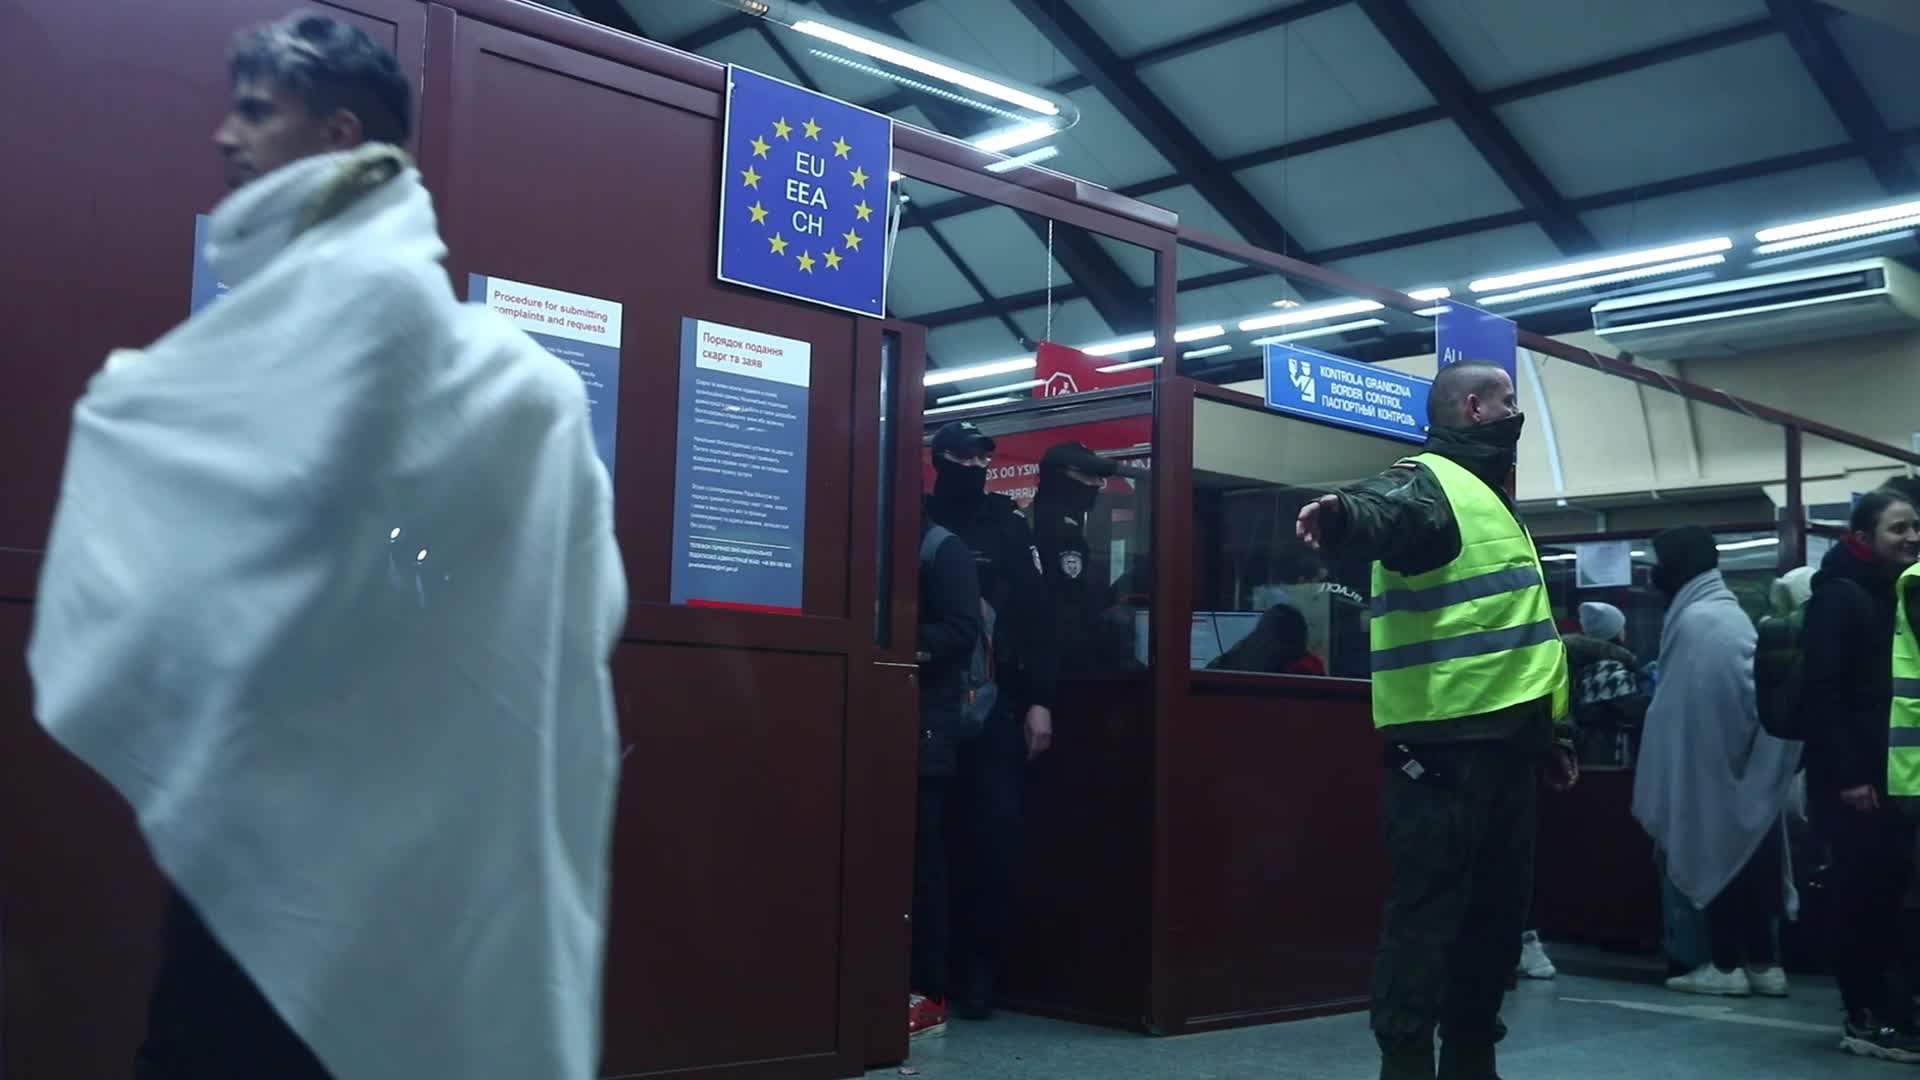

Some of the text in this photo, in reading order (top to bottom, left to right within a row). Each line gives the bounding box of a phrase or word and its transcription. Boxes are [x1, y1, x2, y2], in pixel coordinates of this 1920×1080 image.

[796, 151, 825, 178] EU
[786, 178, 828, 210] EEA
[792, 211, 823, 237] CH
[494, 290, 608, 323] Procedure for submitting
[547, 316, 565, 326] and
[566, 319, 606, 334] requests
[703, 332, 784, 357] Порядок подання
[702, 349, 763, 368] скарг та заяв
[1319, 365, 1412, 398] KONTROLA GRANICZNA
[1321, 394, 1416, 426] ПАСПОРТНЫЙ КОНТРОЛЬ
[1330, 383, 1403, 410] BORDER CONTROL
